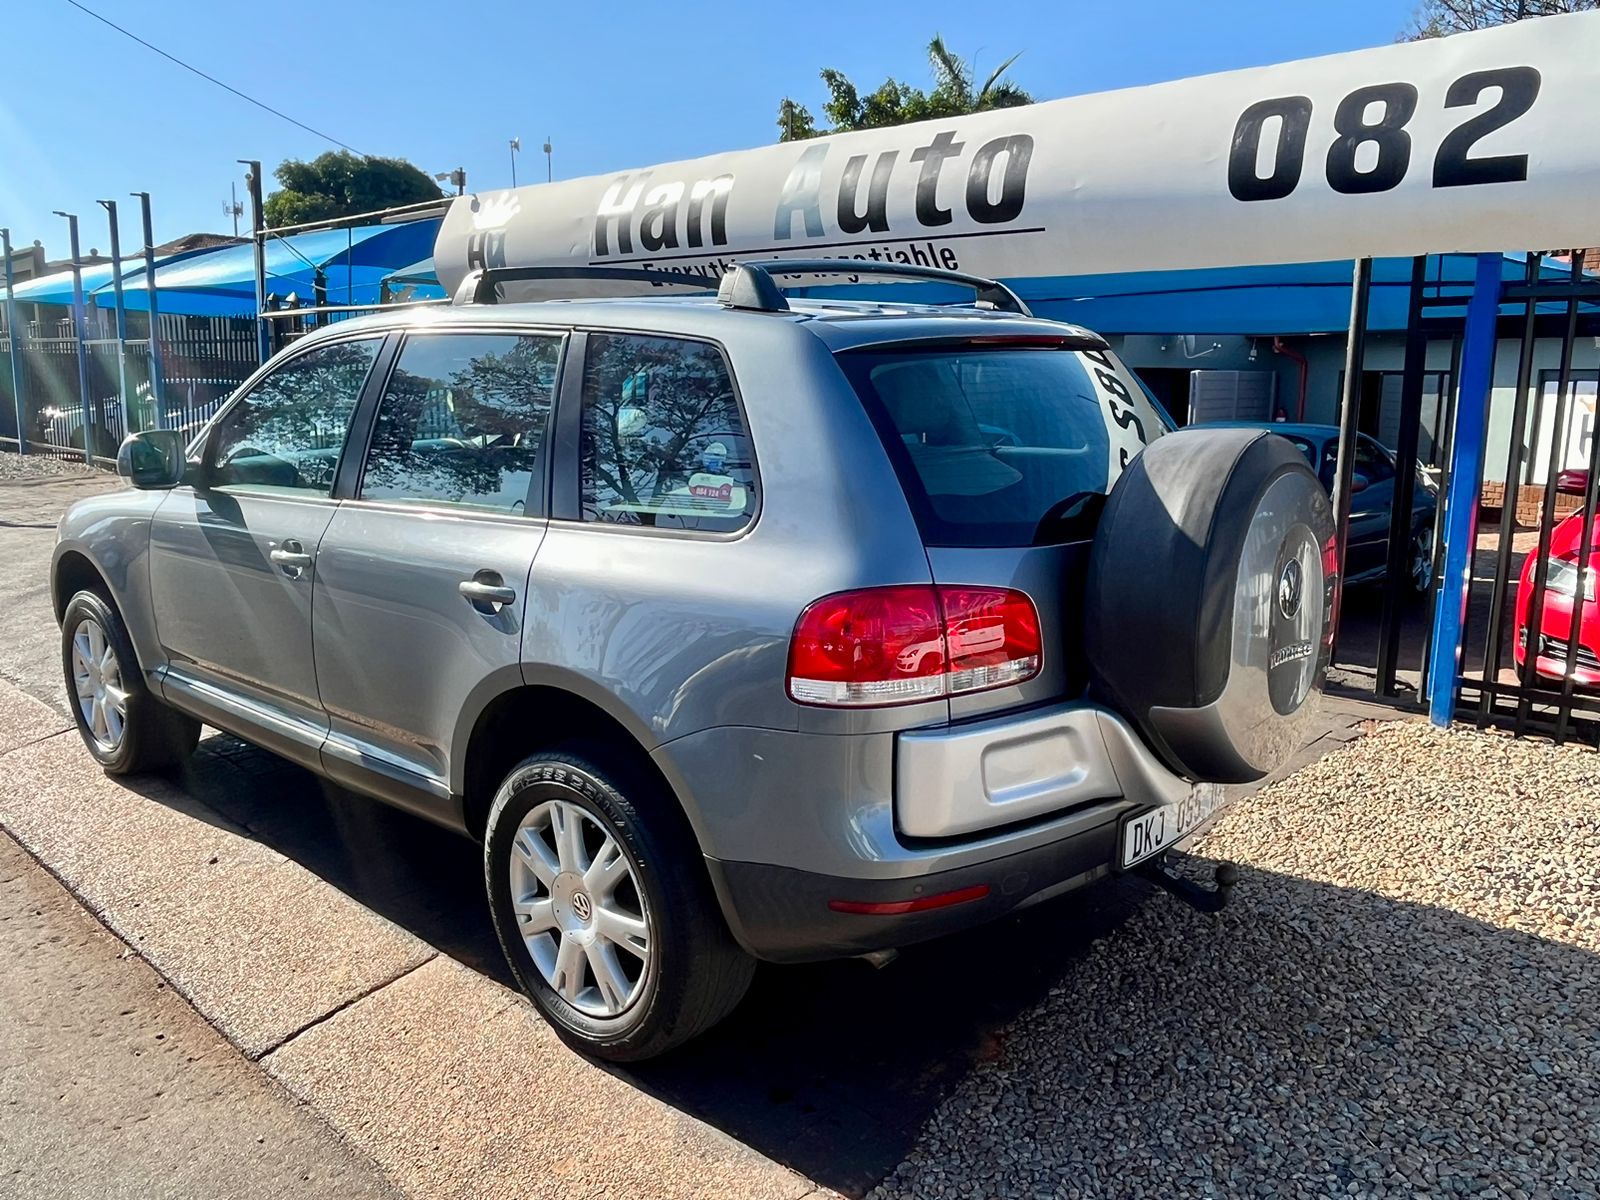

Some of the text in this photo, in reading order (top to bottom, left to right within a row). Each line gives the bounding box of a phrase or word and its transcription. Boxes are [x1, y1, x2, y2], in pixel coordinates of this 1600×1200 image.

[594, 130, 1035, 257] Han Auto
[1227, 65, 1542, 202] 082
[1132, 810, 1165, 860] DKJ
